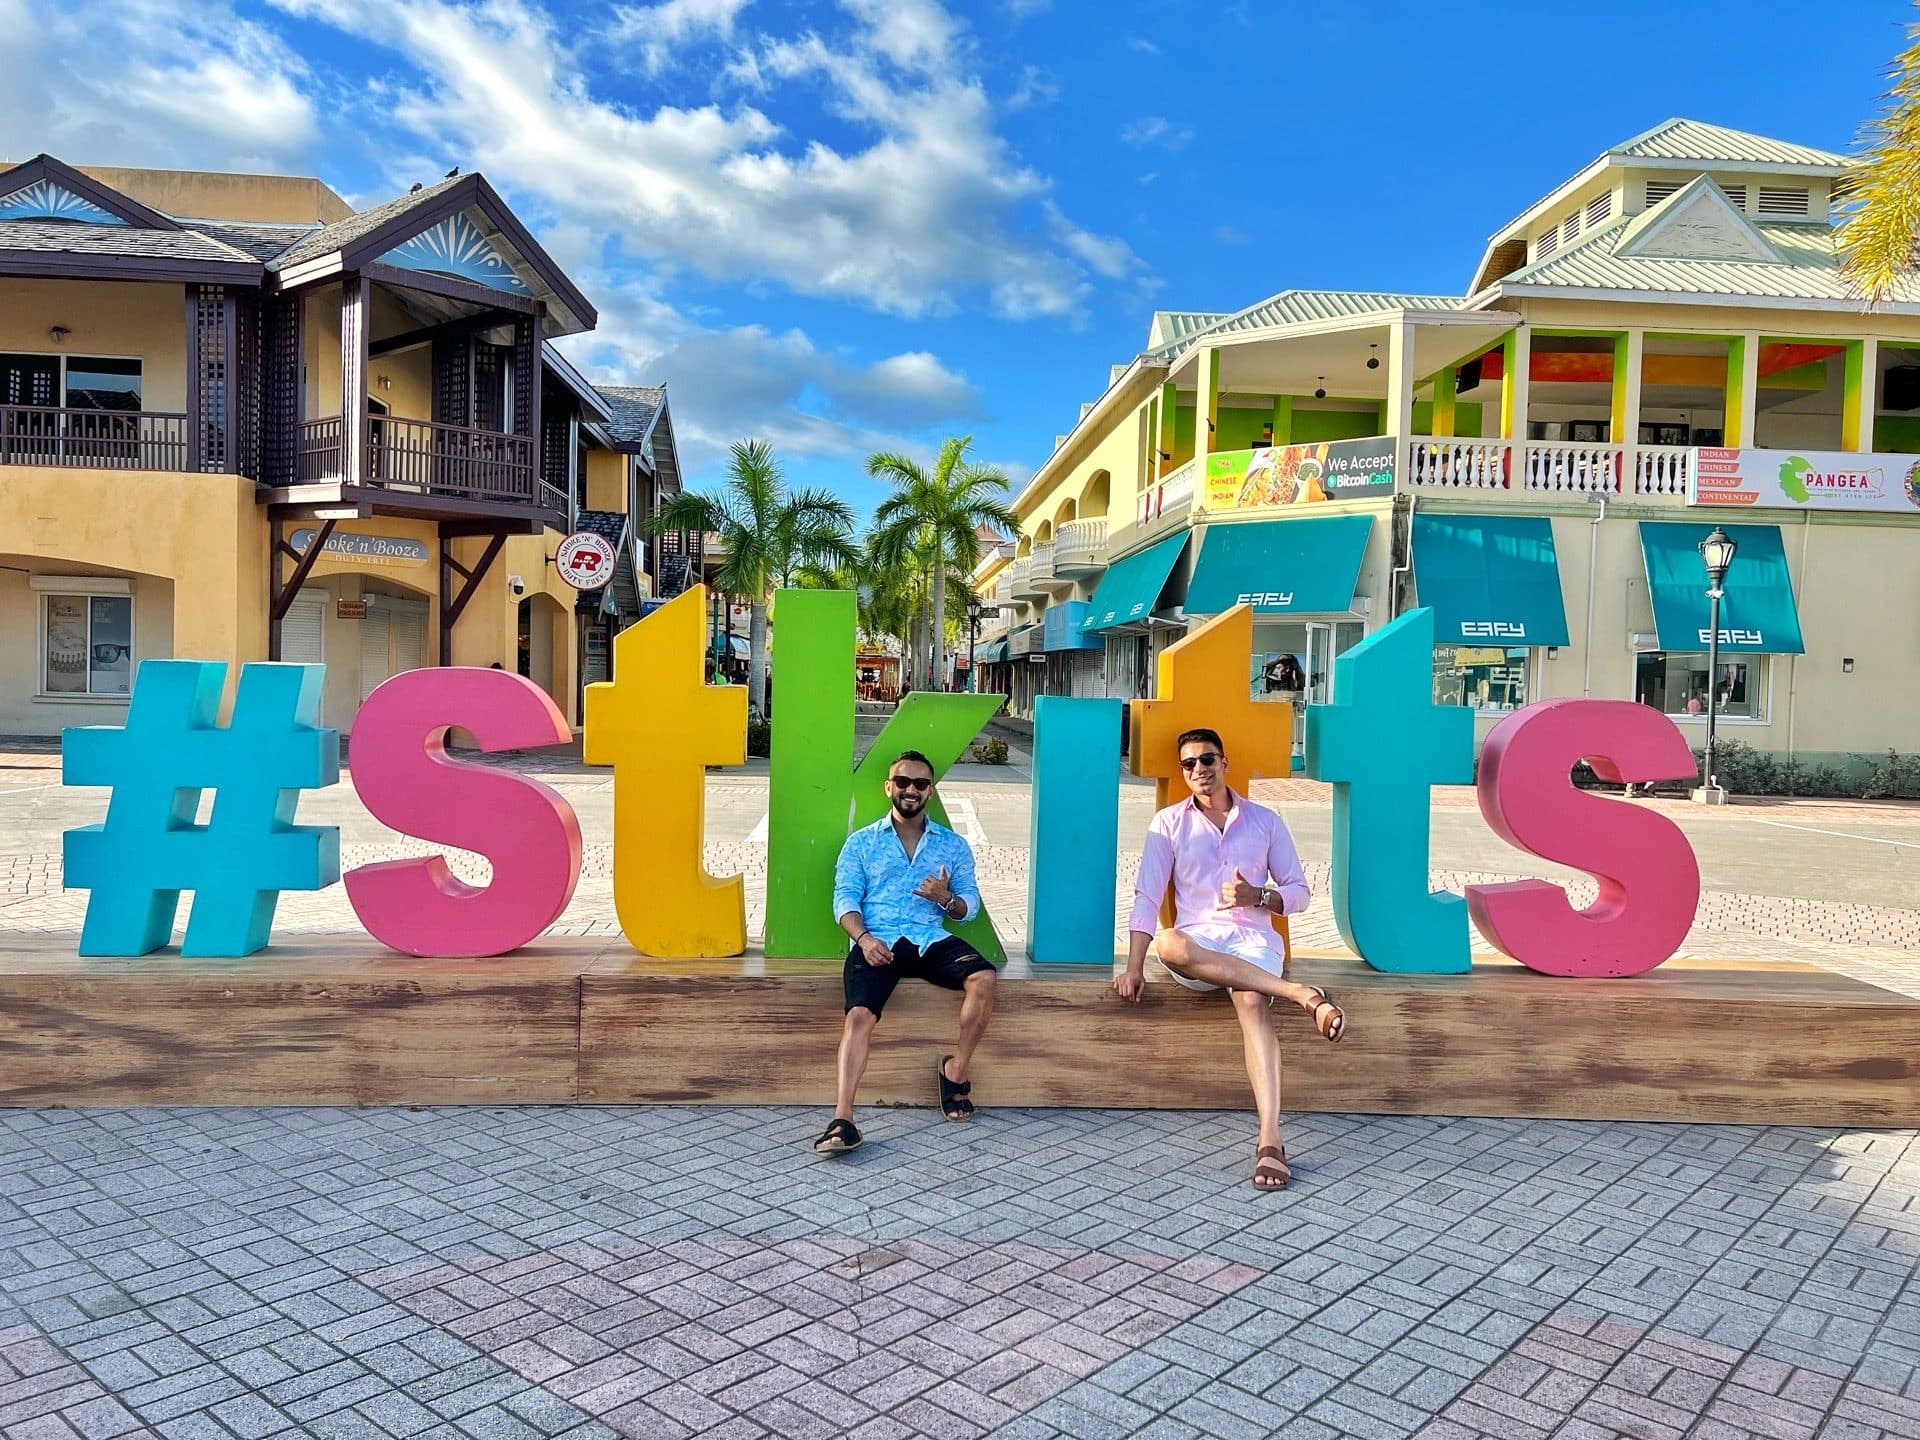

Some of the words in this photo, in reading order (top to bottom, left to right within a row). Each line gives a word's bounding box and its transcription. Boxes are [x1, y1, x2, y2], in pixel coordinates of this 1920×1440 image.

[1700, 450, 1729, 458] INDIAN
[1327, 457, 1348, 471] We
[1350, 453, 1394, 471] Accept
[1699, 463, 1731, 472] CHINESE
[1210, 477, 1237, 486] CHINESE
[1699, 478, 1736, 486] MEXICAN
[1806, 473, 1868, 489] PANGEA
[1212, 492, 1234, 500] INDIAN
[1698, 492, 1753, 501] CONTINENTAL
[560, 536, 582, 558] SMOKE
[594, 539, 612, 561] BOOZE
[335, 554, 362, 563] DUTY
[563, 568, 583, 585] DUTY
